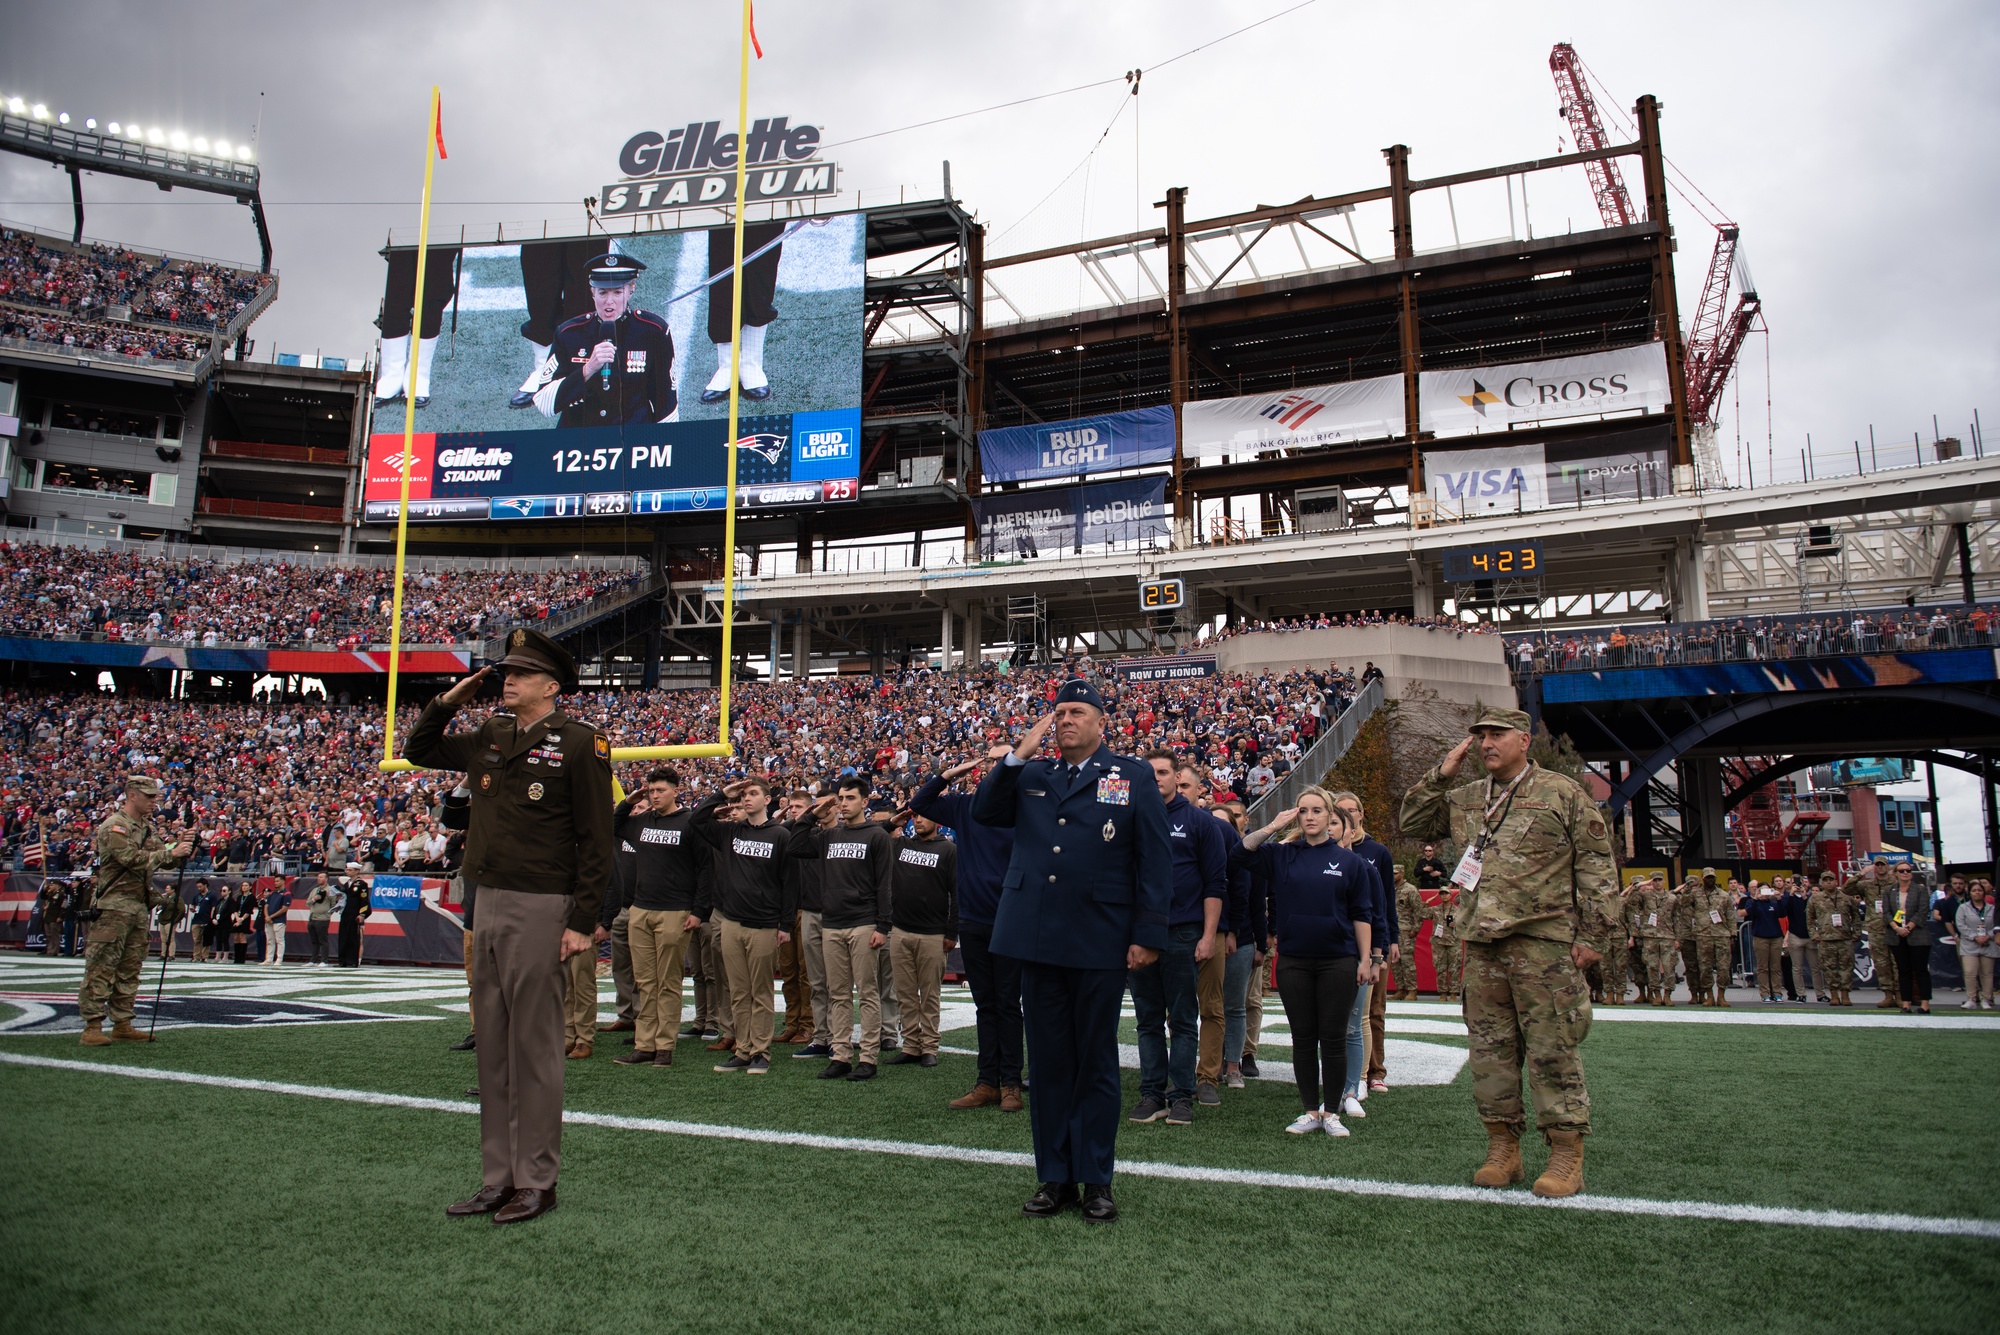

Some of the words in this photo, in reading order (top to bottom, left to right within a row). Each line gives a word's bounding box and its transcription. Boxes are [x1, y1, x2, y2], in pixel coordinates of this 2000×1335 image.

[618, 116, 821, 176] Gillette
[1512, 396, 1628, 414] INSURANCE
[808, 432, 843, 446] BUD
[1050, 428, 1098, 450] BUD
[1246, 440, 1275, 450] BANK
[1277, 438, 1291, 446] OF
[1293, 432, 1342, 445] AMERICA
[438, 447, 513, 467] Gillette
[552, 448, 623, 472] 12:57
[631, 445, 672, 469] PM
[802, 443, 849, 459] LIGHT
[1042, 444, 1108, 468] LIGHT
[442, 469, 502, 482] STADIUM
[1588, 459, 1660, 480] paycom
[829, 482, 850, 499] 25
[1435, 468, 1528, 499] VISA
[651, 492, 661, 511] 0
[759, 487, 815, 503] Gillette
[369, 506, 386, 514] DOWN
[417, 506, 425, 514] GO
[426, 504, 441, 516] 10
[555, 496, 566, 516] 0
[590, 495, 625, 514] 4:23
[984, 508, 1063, 530] J.DERENZO
[1085, 500, 1152, 531] jetBlue
[999, 526, 1050, 540] COMPANIES
[1472, 548, 1536, 571] 4:23
[1146, 584, 1177, 605] 25
[1129, 670, 1152, 680] ROW
[1154, 669, 1167, 678] OF
[1169, 667, 1205, 677] HONOR
[1813, 765, 1831, 774] xfinity
[640, 833, 680, 845] GUARD
[899, 853, 937, 867] GUARD
[380, 887, 398, 898] CBS
[401, 888, 418, 898] NFL
